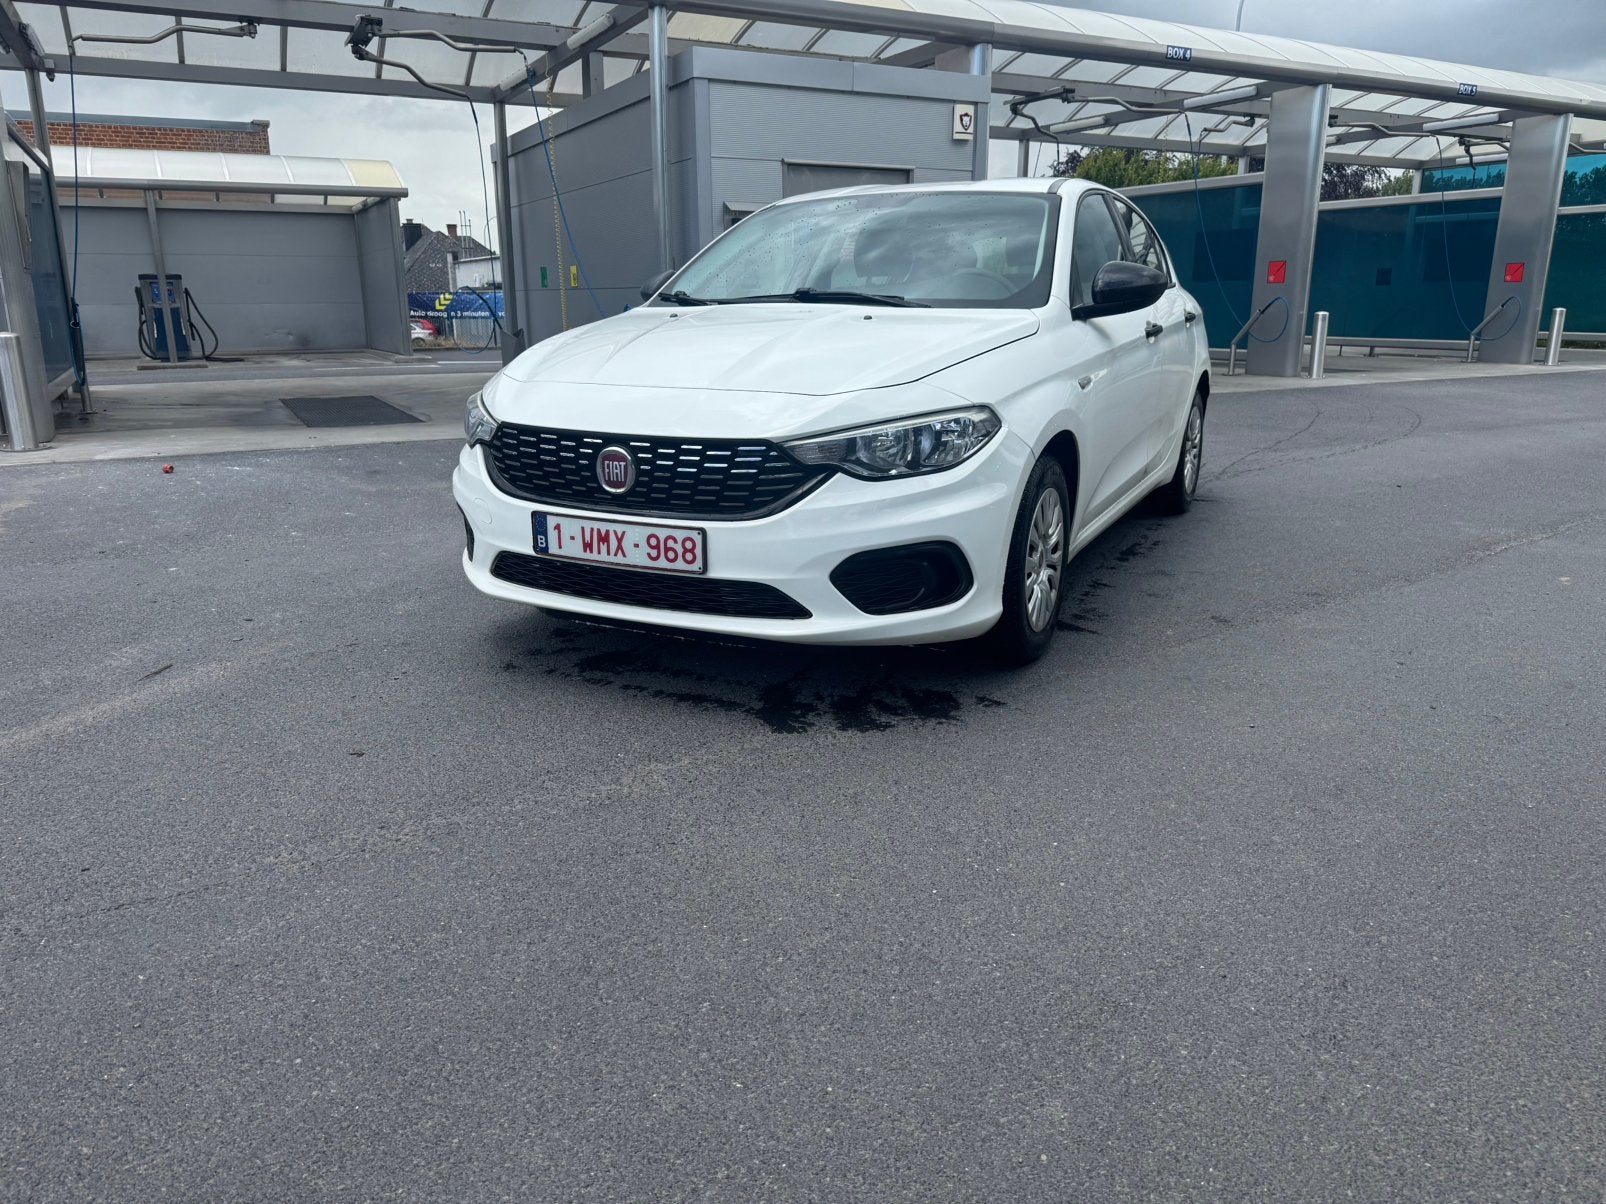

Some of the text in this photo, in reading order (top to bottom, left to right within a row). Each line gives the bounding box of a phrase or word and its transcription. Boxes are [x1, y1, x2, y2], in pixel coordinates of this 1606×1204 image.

[1167, 46, 1191, 60] BOX 4
[1459, 84, 1473, 95] BOX
[427, 310, 448, 318] droog
[604, 460, 627, 482] FIAT
[537, 535, 546, 547] B
[553, 523, 697, 565] 1-WMX-968
